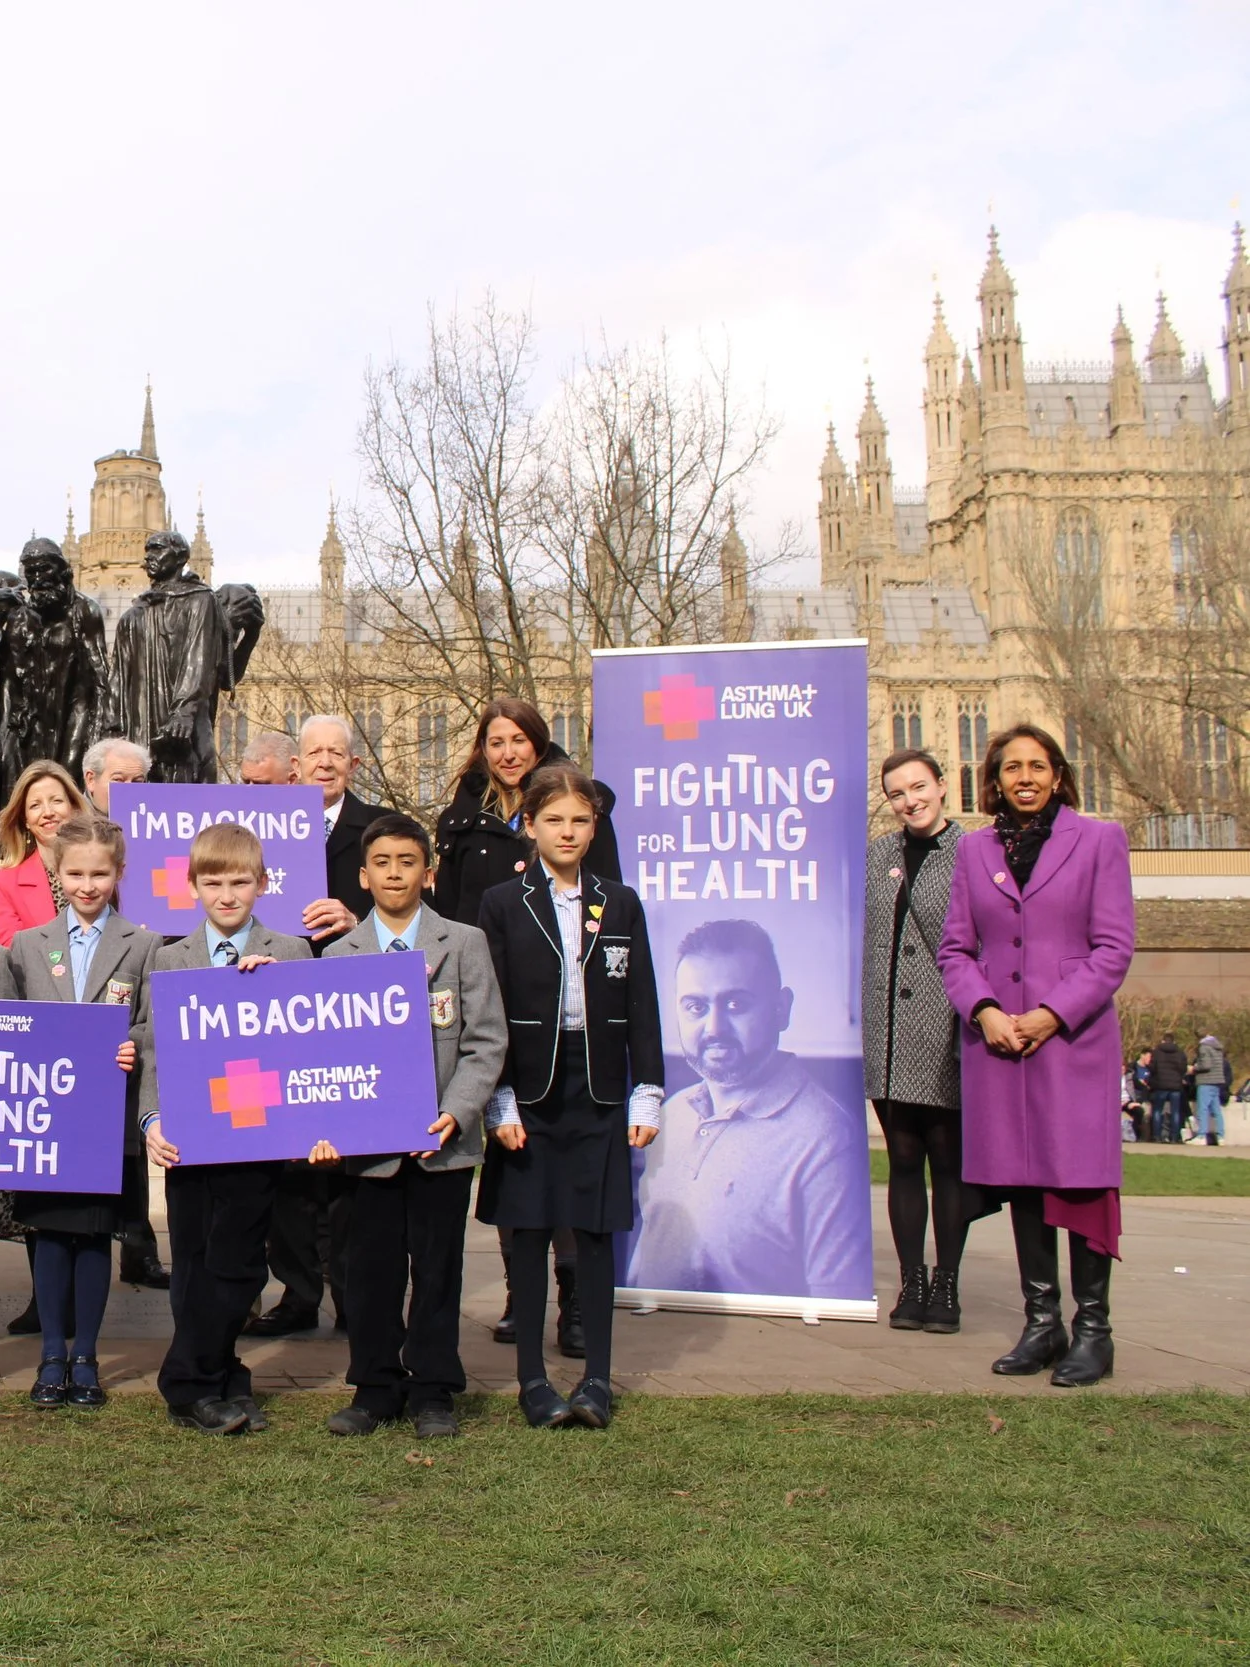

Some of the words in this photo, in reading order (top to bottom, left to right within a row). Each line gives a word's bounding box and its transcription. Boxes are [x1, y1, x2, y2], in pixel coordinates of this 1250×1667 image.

[721, 683, 818, 702] ASTHMA+
[720, 702, 776, 719] LUNG
[784, 701, 813, 718] UK
[634, 753, 835, 807] FIGHTING
[130, 802, 171, 840] I'M
[637, 833, 676, 853] FOR
[682, 806, 807, 853] LUNG
[638, 858, 818, 901] HEALTH
[18, 1024, 30, 1032] UK
[179, 994, 230, 1041] I'M
[237, 984, 411, 1036] BACKING
[286, 1063, 382, 1087] ASTHMA+
[286, 1082, 342, 1105] LUNG
[349, 1079, 378, 1101] UK
